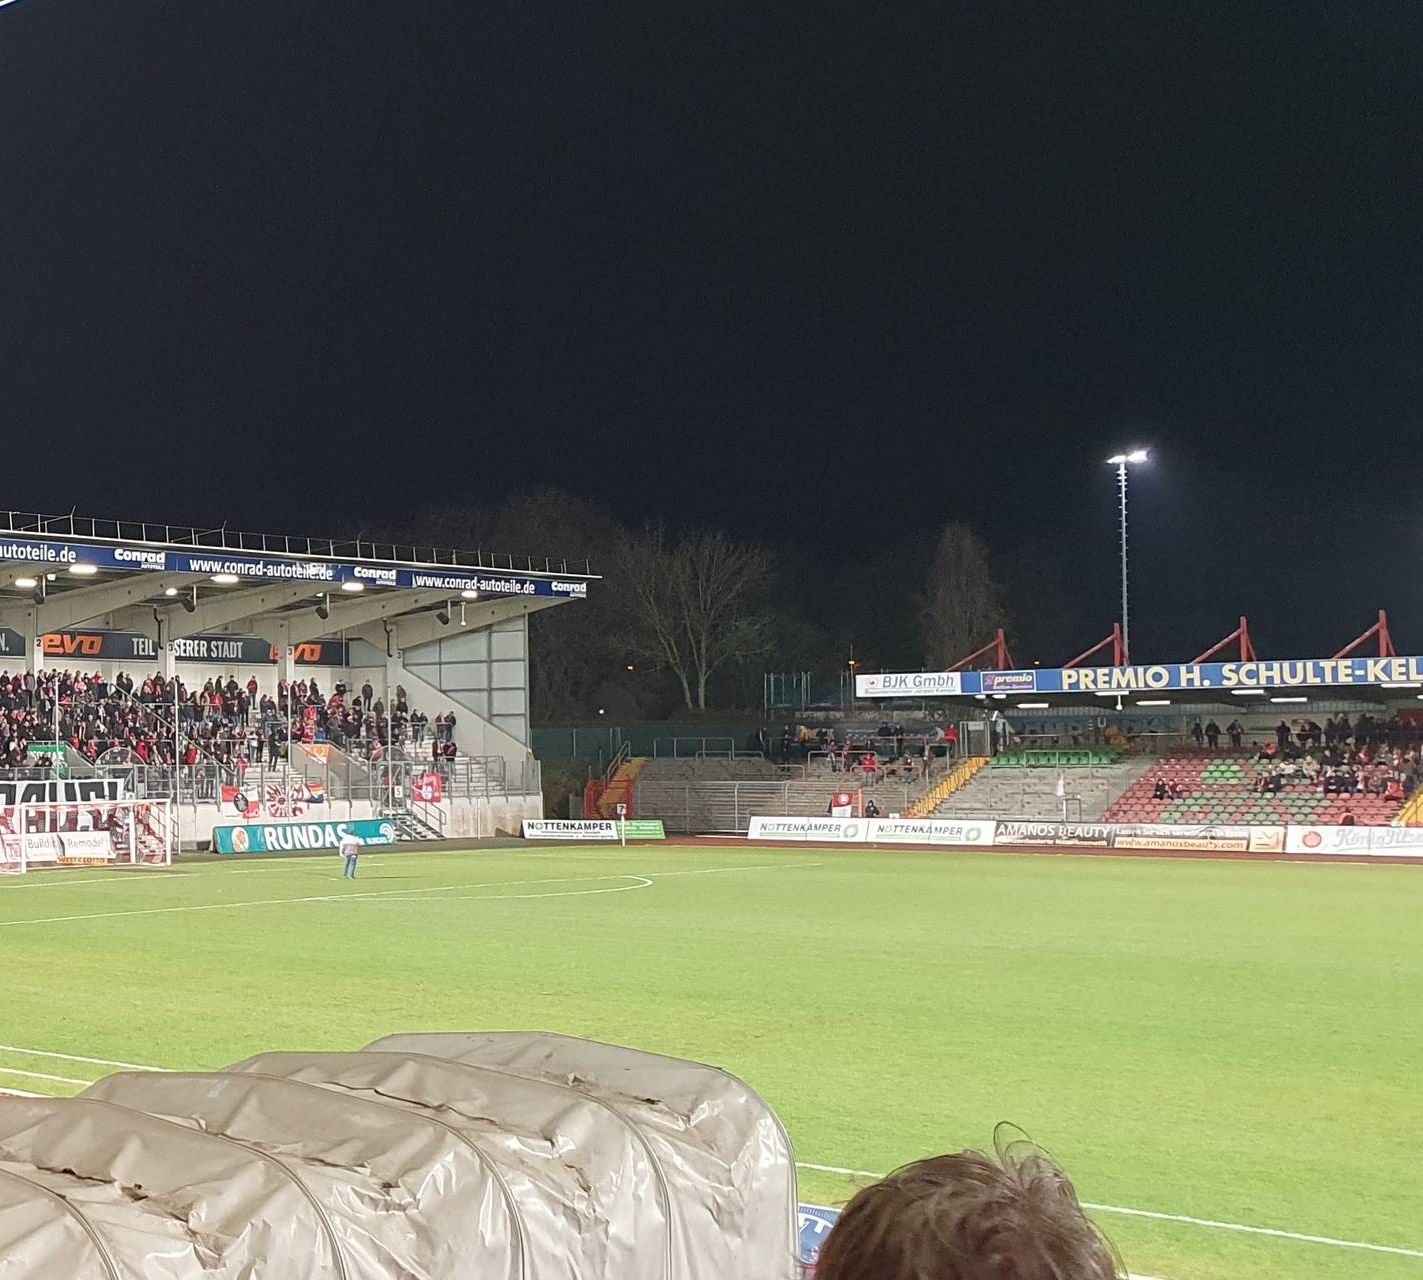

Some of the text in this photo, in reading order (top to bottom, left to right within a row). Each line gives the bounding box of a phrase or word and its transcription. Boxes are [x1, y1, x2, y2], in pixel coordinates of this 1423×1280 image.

[114, 549, 165, 564] Conrad
[190, 559, 333, 580] www.conrad-autoteile.de
[354, 567, 397, 580] Conrad
[416, 574, 535, 595] www.conrad-autoteile.de
[551, 581, 587, 593] Conrad
[43, 633, 102, 655] evo
[132, 637, 243, 659] TEIL SERER STADT
[883, 674, 954, 688] BJK Gmbh
[993, 674, 1033, 685] premio
[1062, 658, 1423, 690] PREMIO H. SCHULTE-KEL
[264, 824, 348, 851] RUNDAS
[997, 823, 1055, 837] AMANOS
[1058, 825, 1110, 838] BEAUTY
